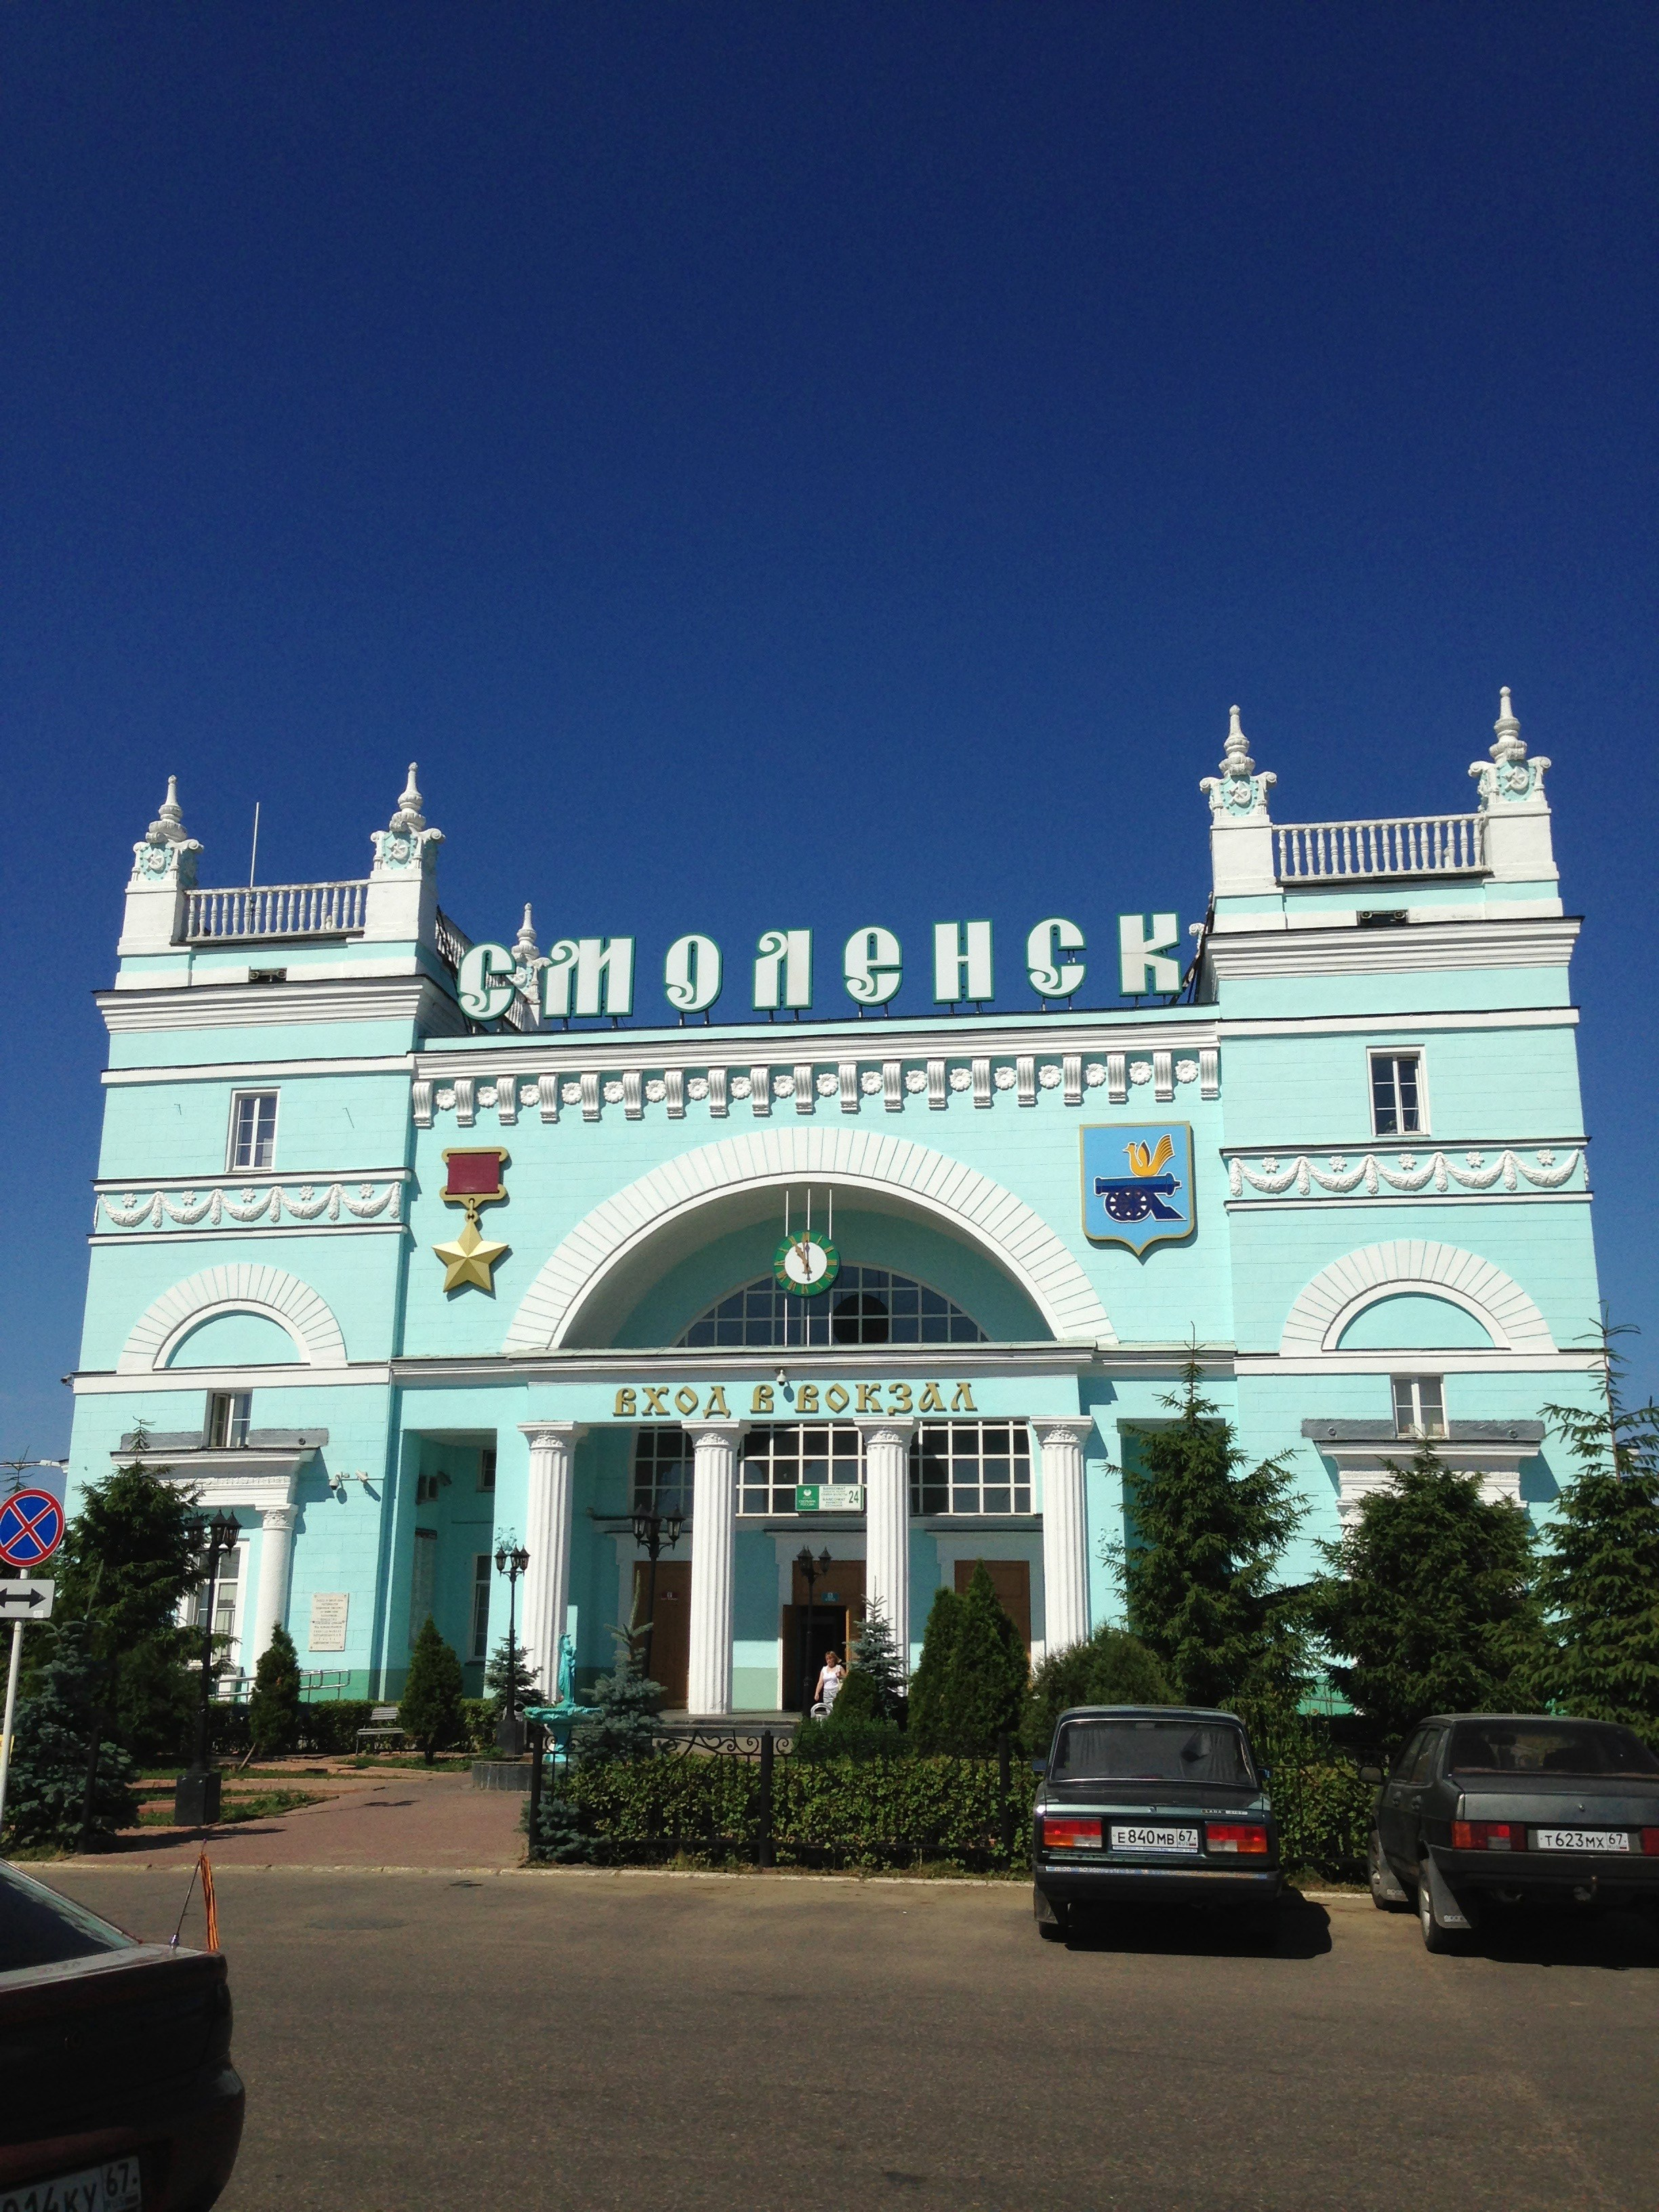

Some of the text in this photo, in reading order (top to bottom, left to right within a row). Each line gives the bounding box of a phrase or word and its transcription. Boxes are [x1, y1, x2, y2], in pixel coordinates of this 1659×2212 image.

[457, 912, 1183, 1021] СМОЛЕНСК
[613, 1382, 979, 1418] ВХОД В ВОКЗАЛ
[848, 1490, 859, 1503] 24
[1179, 1830, 1192, 1842] 67
[1608, 1833, 1622, 1845] 67
[106, 2162, 129, 2197] 67
